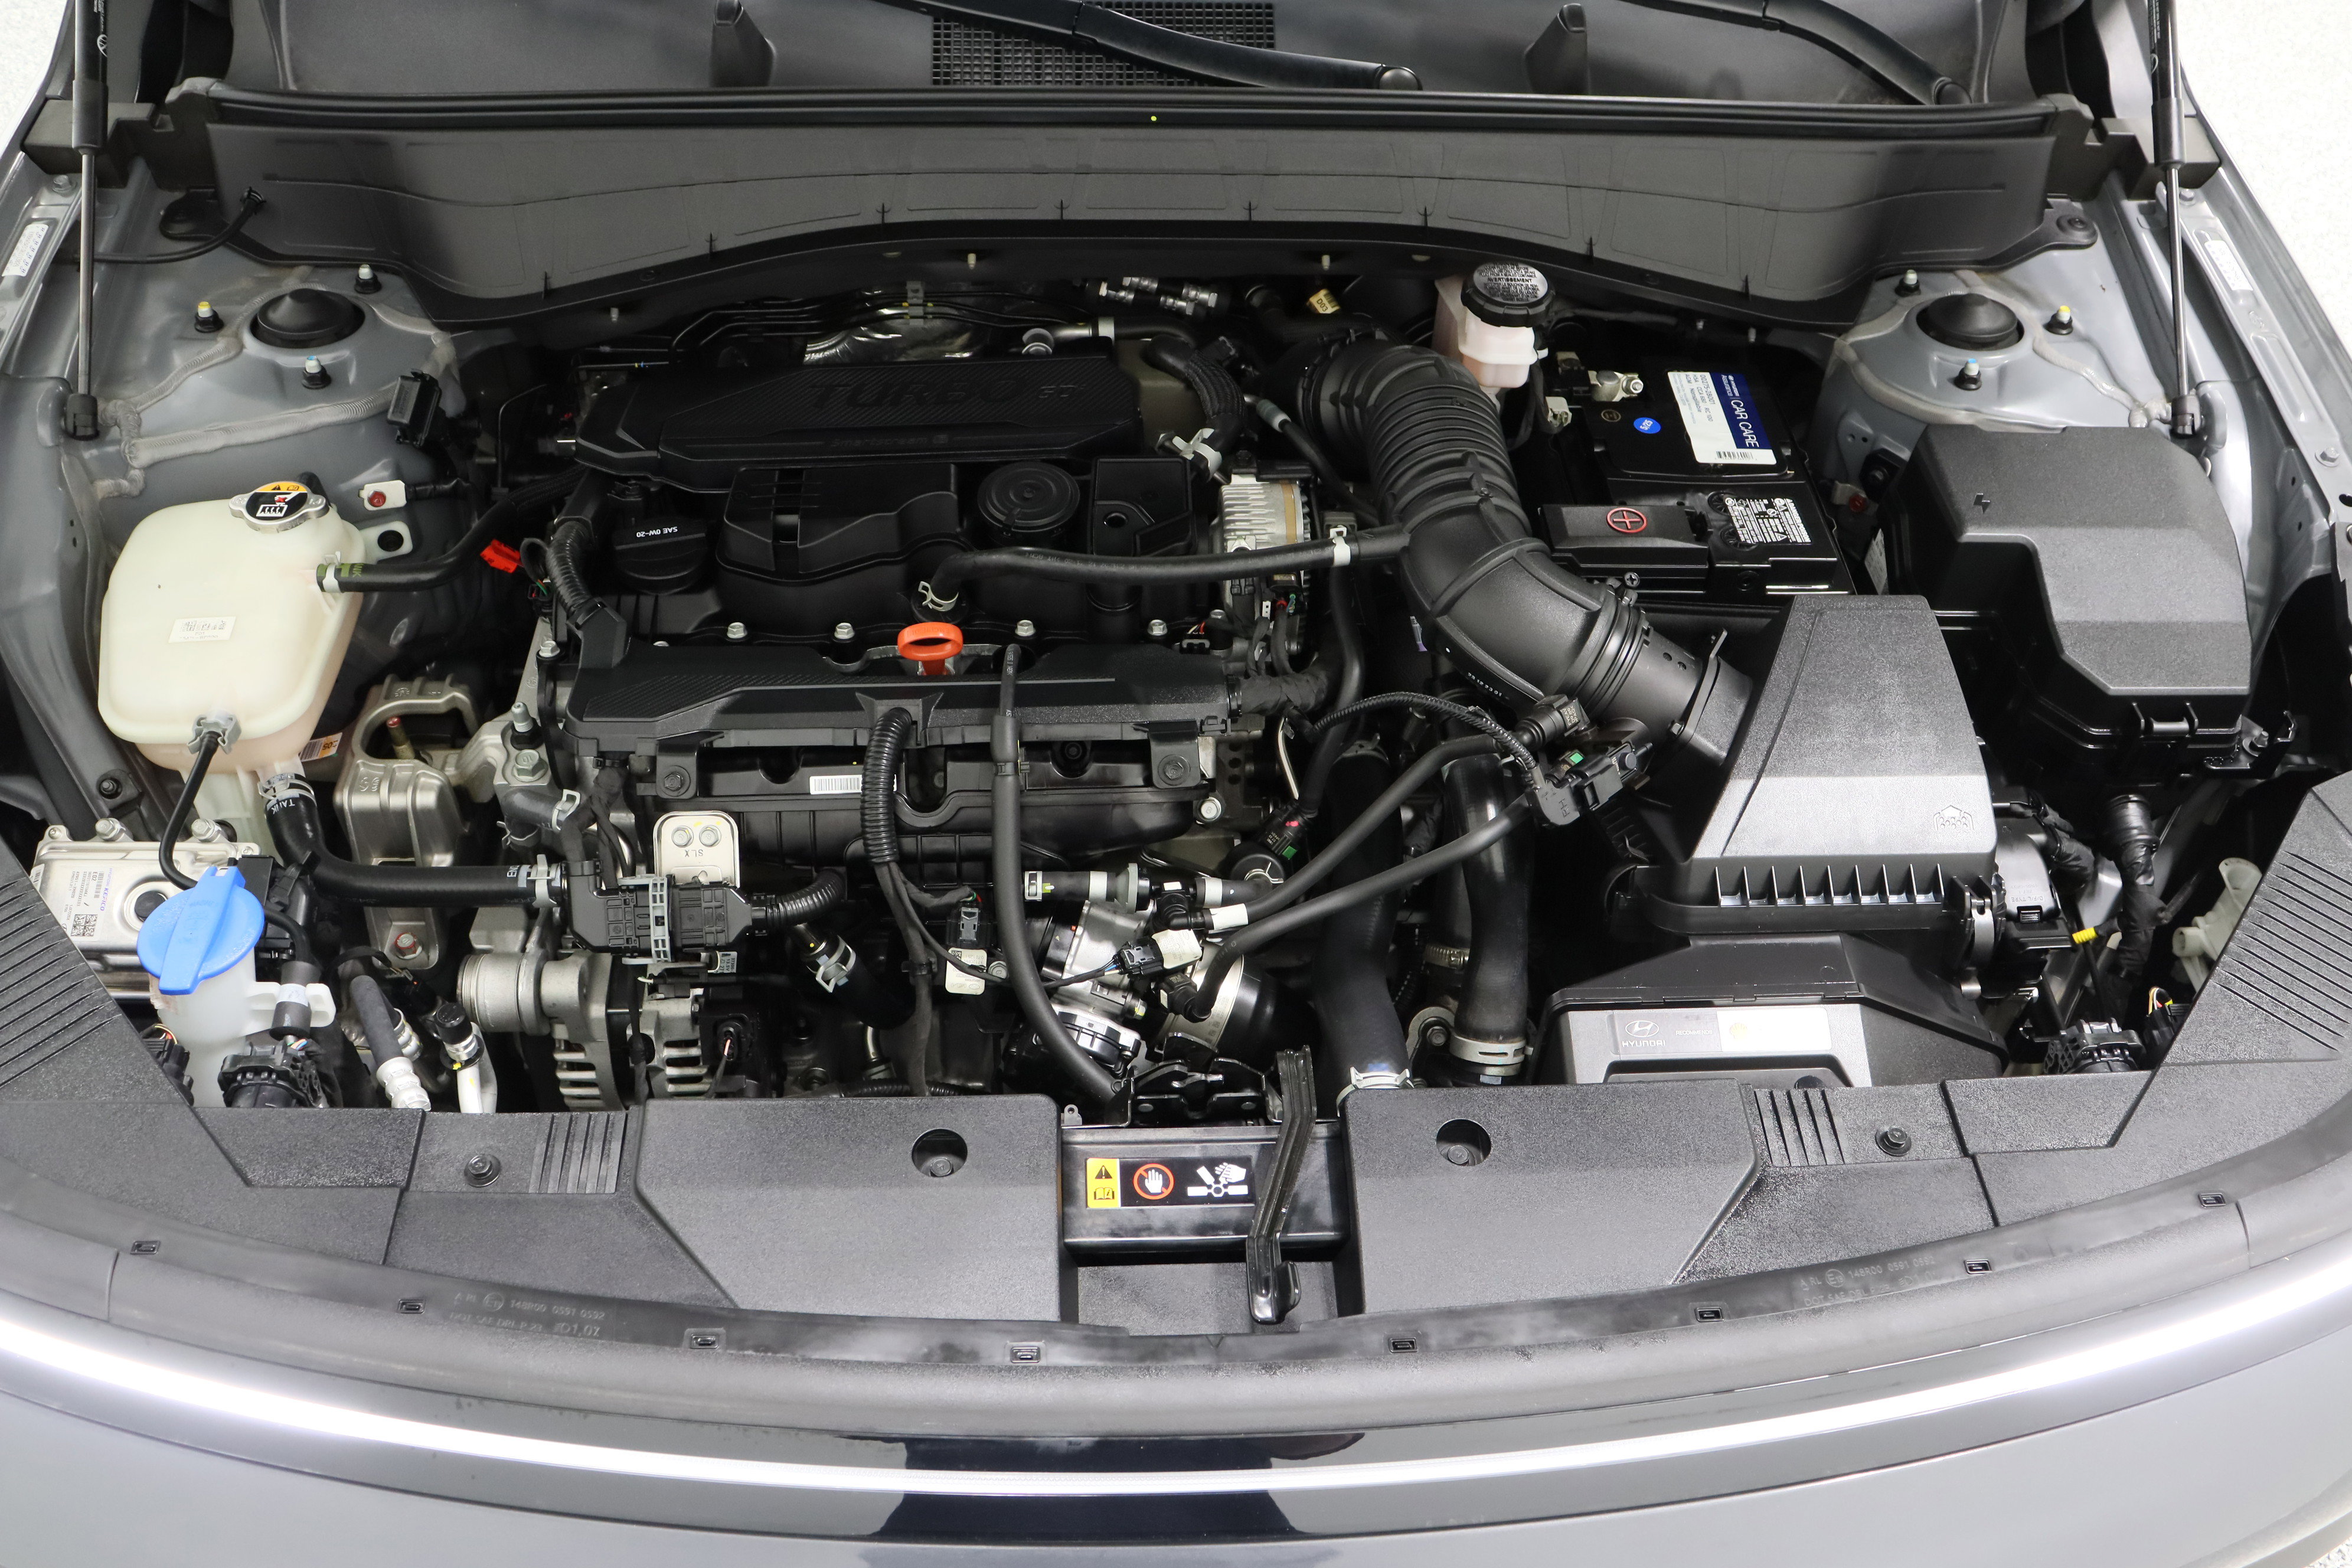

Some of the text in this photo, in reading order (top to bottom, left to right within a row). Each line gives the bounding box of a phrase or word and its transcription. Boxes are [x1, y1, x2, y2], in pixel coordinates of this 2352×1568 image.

[1317, 298, 1328, 312] D03
[809, 380, 1020, 408] TURBO
[1700, 375, 1715, 404] 00275-28001
[1721, 375, 1733, 396] Assurance
[1690, 388, 1701, 413] Nonspillable
[1639, 419, 1653, 430] 5/25
[1731, 400, 1760, 447] CAR CARE
[831, 437, 927, 447] Smartstream
[636, 529, 661, 537] 0W-20
[271, 799, 295, 814] TANK
[1559, 798, 1570, 817] RH
[684, 849, 704, 857] SLX
[100, 888, 109, 911] KEFICO
[1811, 1276, 1822, 1286] RL
[1848, 1265, 1883, 1279] 148R00
[1887, 1261, 1910, 1272] 0591
[1805, 1296, 1824, 1306] DOT
[1828, 1292, 1845, 1302] SAE
[1850, 1288, 1868, 1299] DRL
[450, 1312, 472, 1322] DOT
[476, 1315, 493, 1325] SAE
[510, 1299, 547, 1312] 148R00
[552, 1305, 576, 1317] 0591
[580, 1309, 605, 1320] 0592
